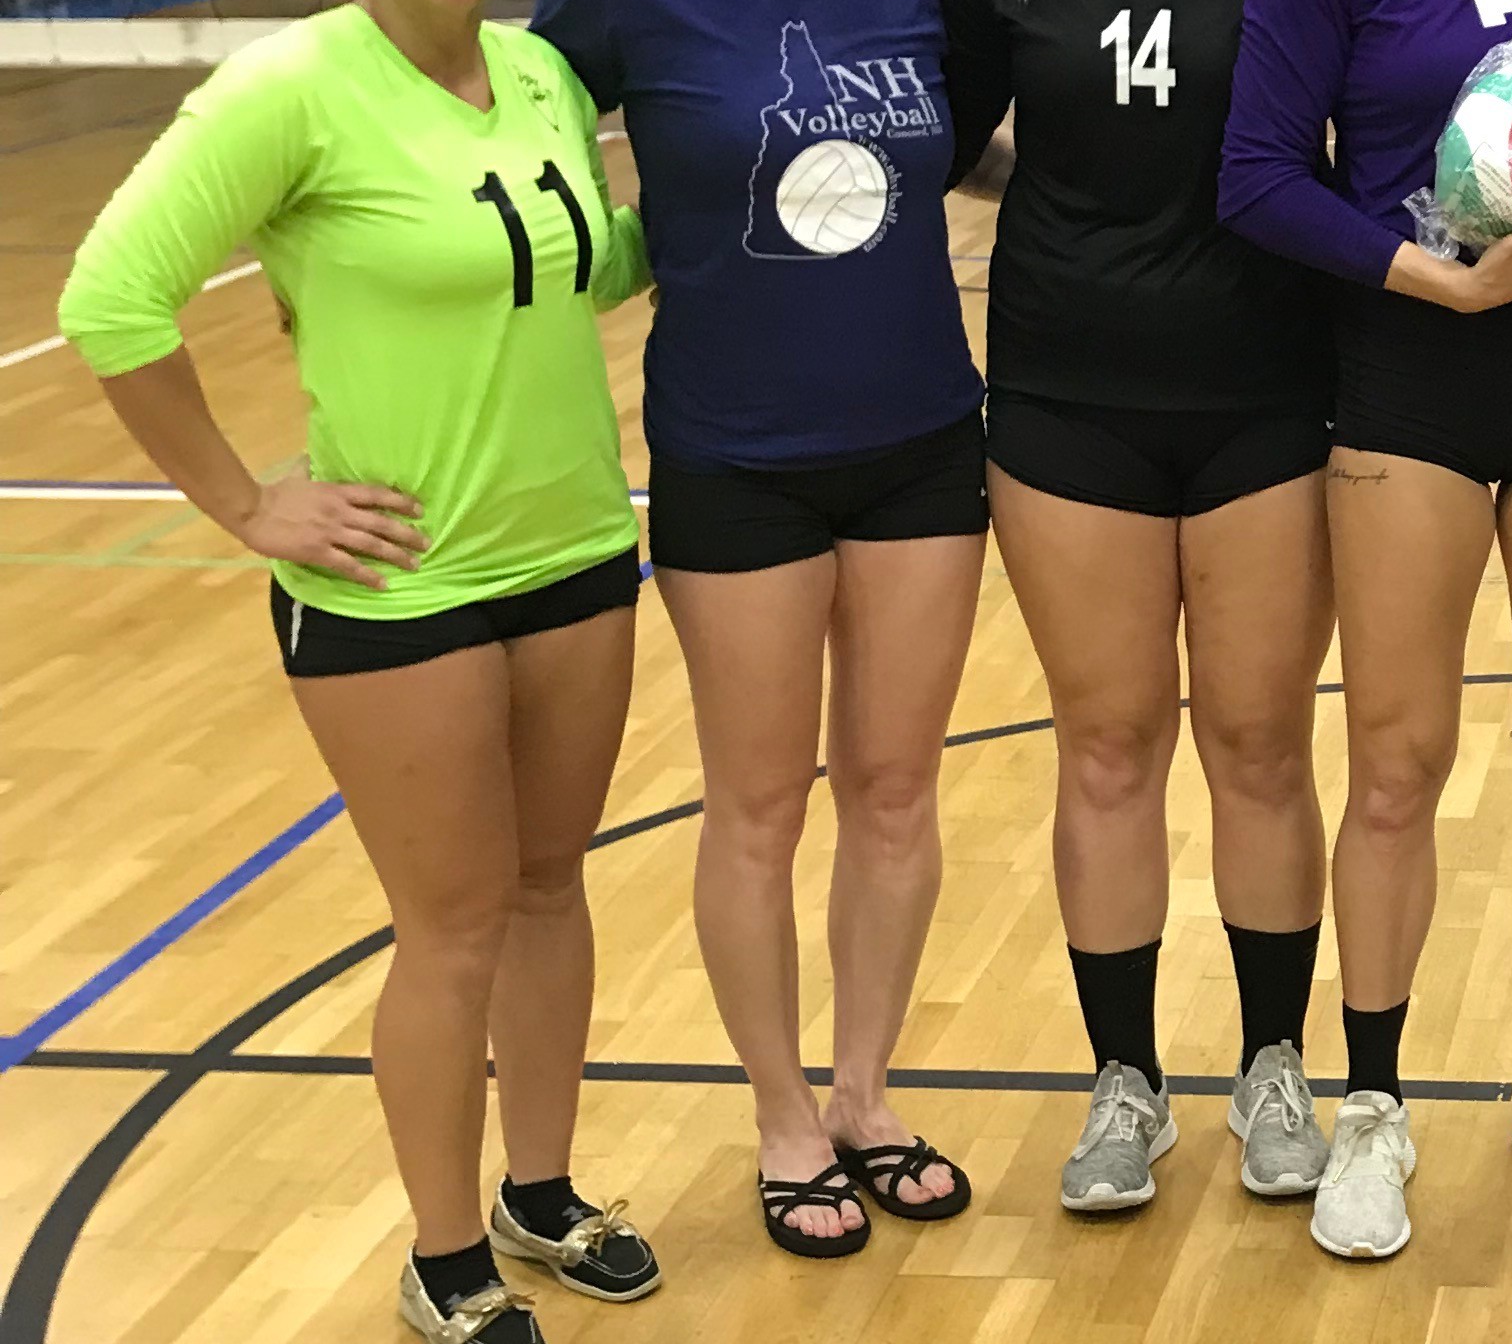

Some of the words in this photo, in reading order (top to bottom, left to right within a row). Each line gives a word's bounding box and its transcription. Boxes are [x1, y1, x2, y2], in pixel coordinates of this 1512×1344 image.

[826, 57, 928, 102] NH
[1101, 9, 1176, 107] 14
[777, 96, 940, 137] Volleyball
[471, 159, 593, 309] 11
